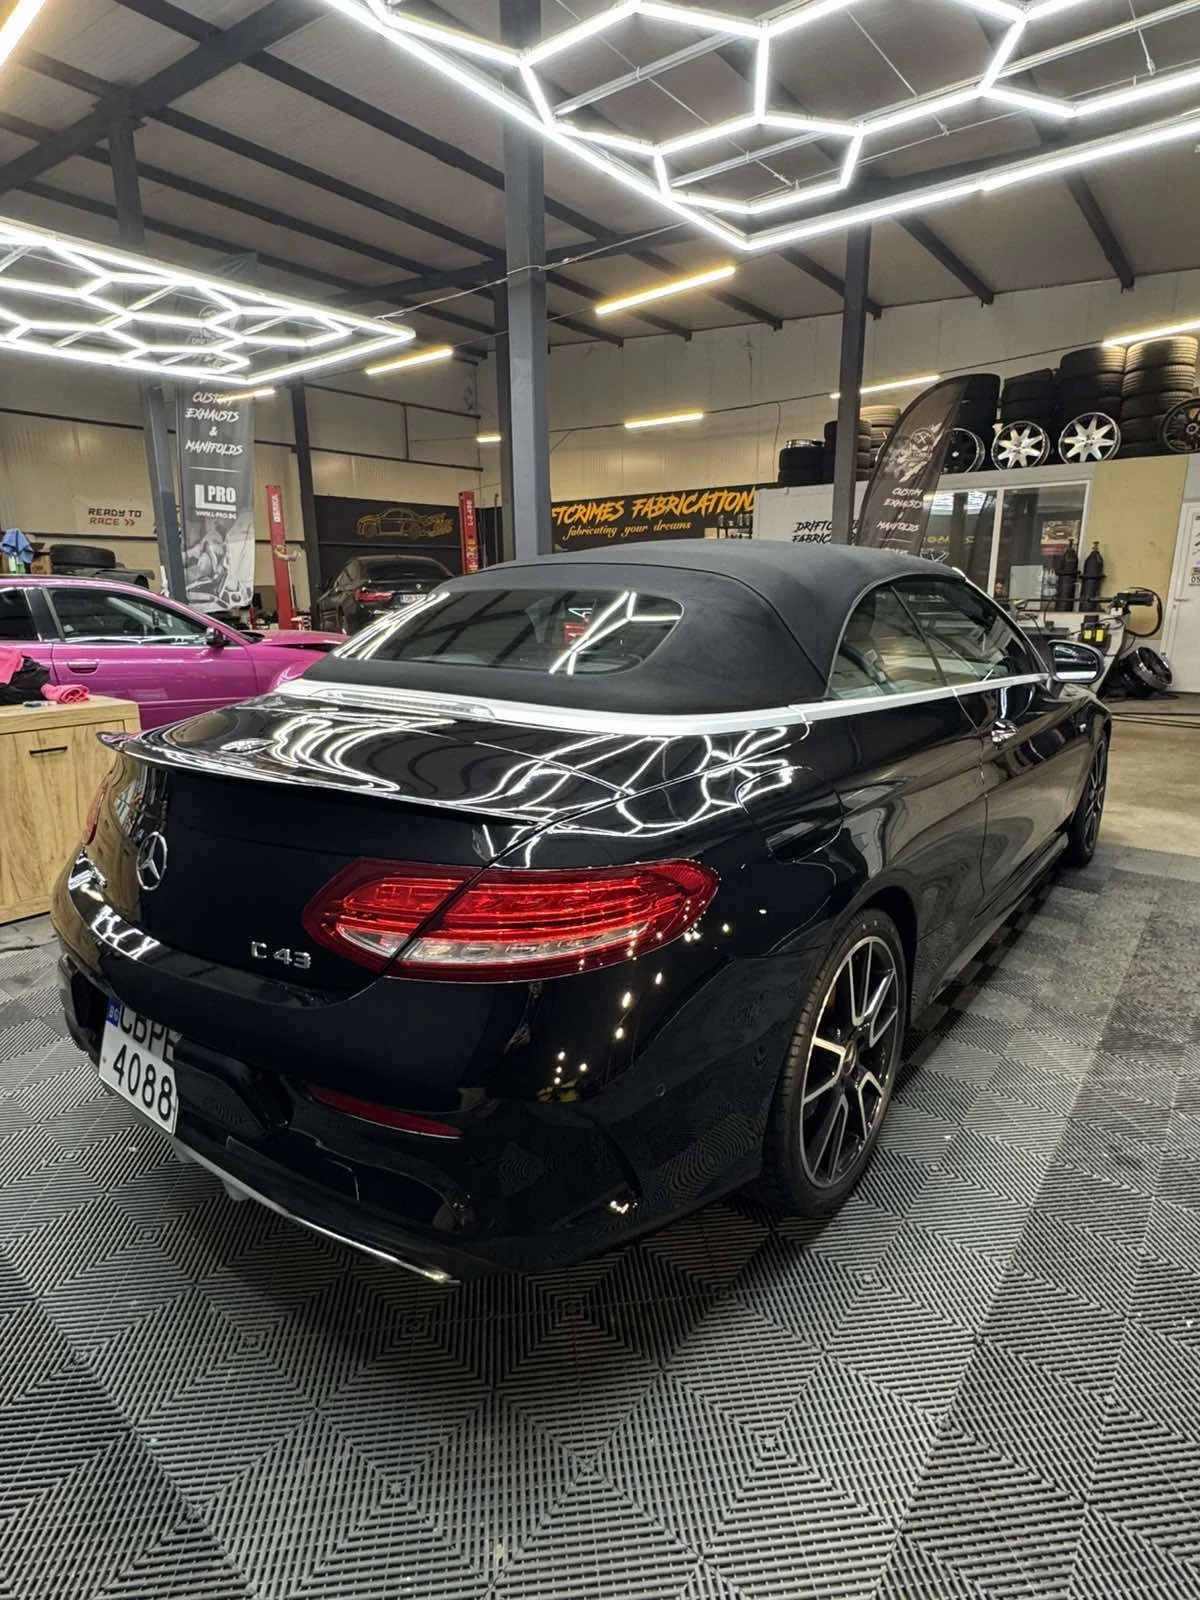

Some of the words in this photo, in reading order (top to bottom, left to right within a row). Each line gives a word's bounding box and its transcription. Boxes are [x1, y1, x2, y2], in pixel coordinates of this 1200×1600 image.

[184, 407, 240, 422] EXHAUSTS
[209, 426, 218, 437] &
[184, 440, 243, 456] MANIFOLDS
[88, 507, 126, 518] READY
[128, 509, 142, 518] TO
[89, 517, 120, 526] RACE
[795, 520, 833, 533] DRIFTC
[562, 525, 618, 541] fabricating
[620, 523, 649, 538] your
[653, 519, 692, 532] dreams
[791, 533, 833, 545] FABRIC
[251, 940, 268, 959] C
[273, 948, 312, 969] 43
[112, 1043, 173, 1122] 4088
